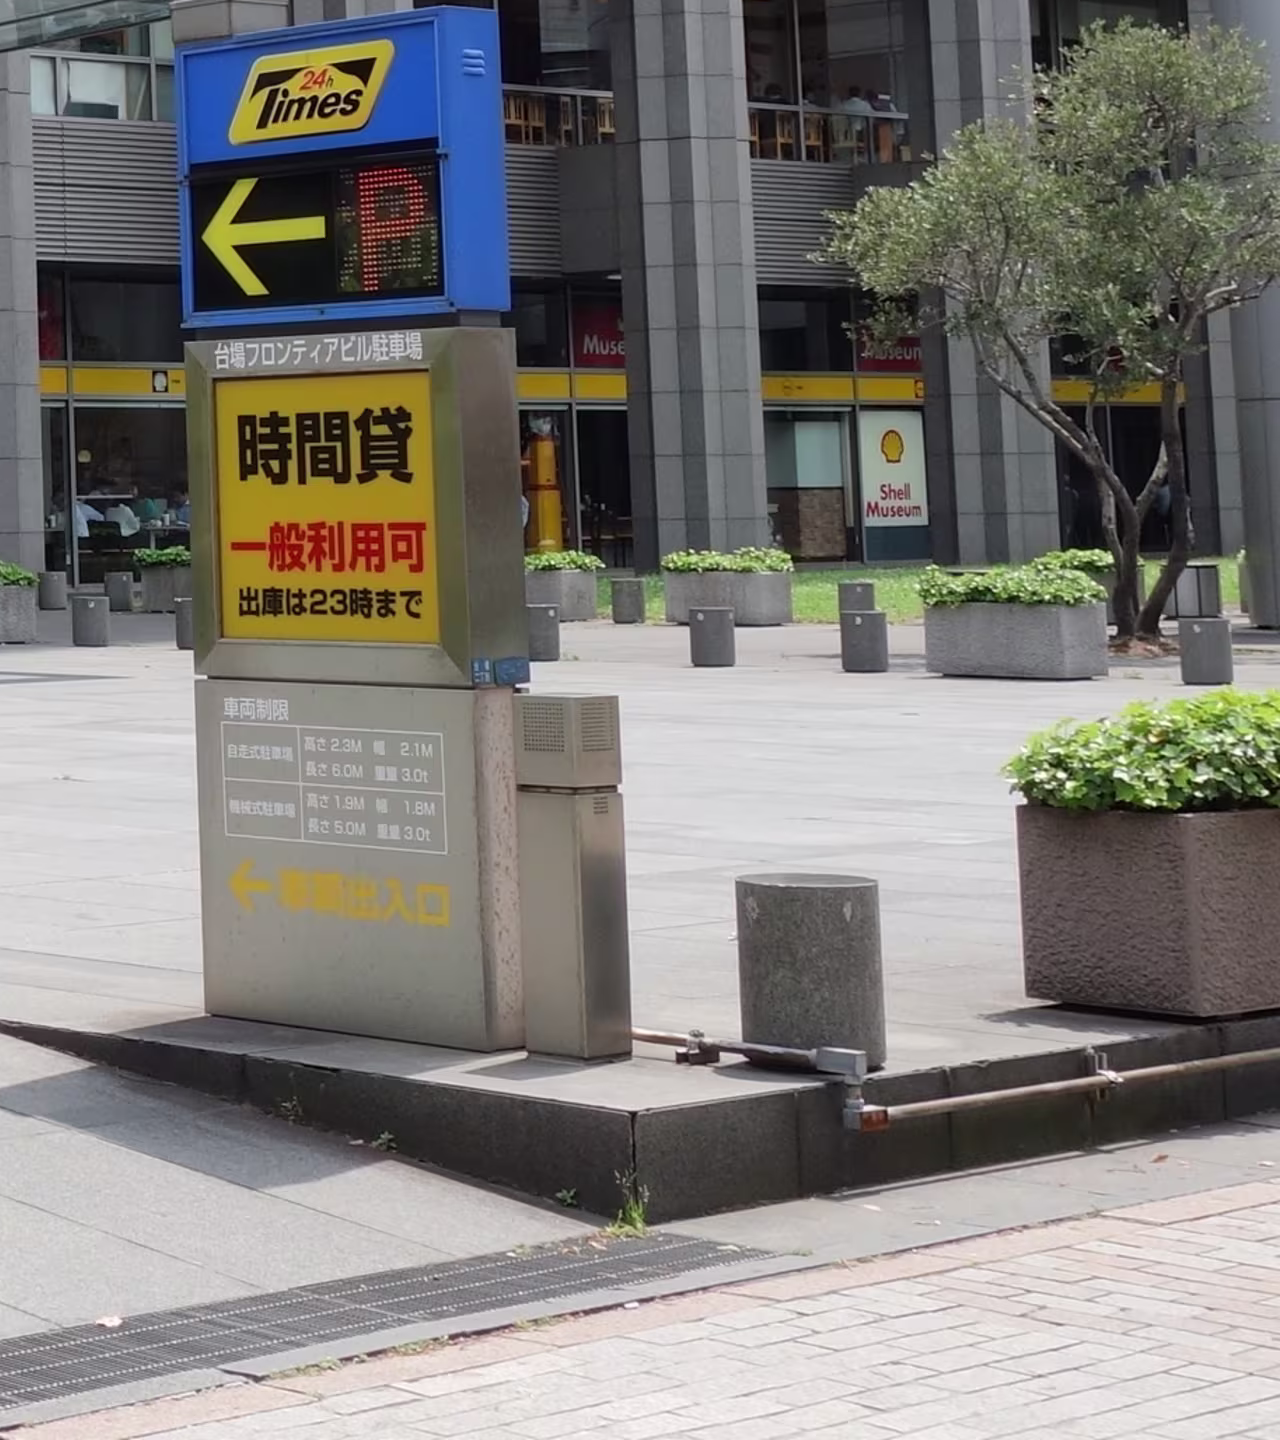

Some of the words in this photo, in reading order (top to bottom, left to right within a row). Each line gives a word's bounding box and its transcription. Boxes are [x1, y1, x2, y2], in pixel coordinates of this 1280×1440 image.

[251, 77, 364, 130] Times
[214, 332, 423, 370] 台場フロンティアビル駐車場
[237, 406, 414, 486] 時間貸
[880, 483, 911, 501] Shell
[866, 501, 922, 518] Museum
[230, 521, 427, 574] 一般利用可
[238, 587, 423, 620] 出庫は23時まで
[224, 697, 289, 721] 車両制限
[400, 742, 433, 758] 2.1M
[401, 768, 429, 783] 3.0t
[404, 826, 431, 842] 3.0t
